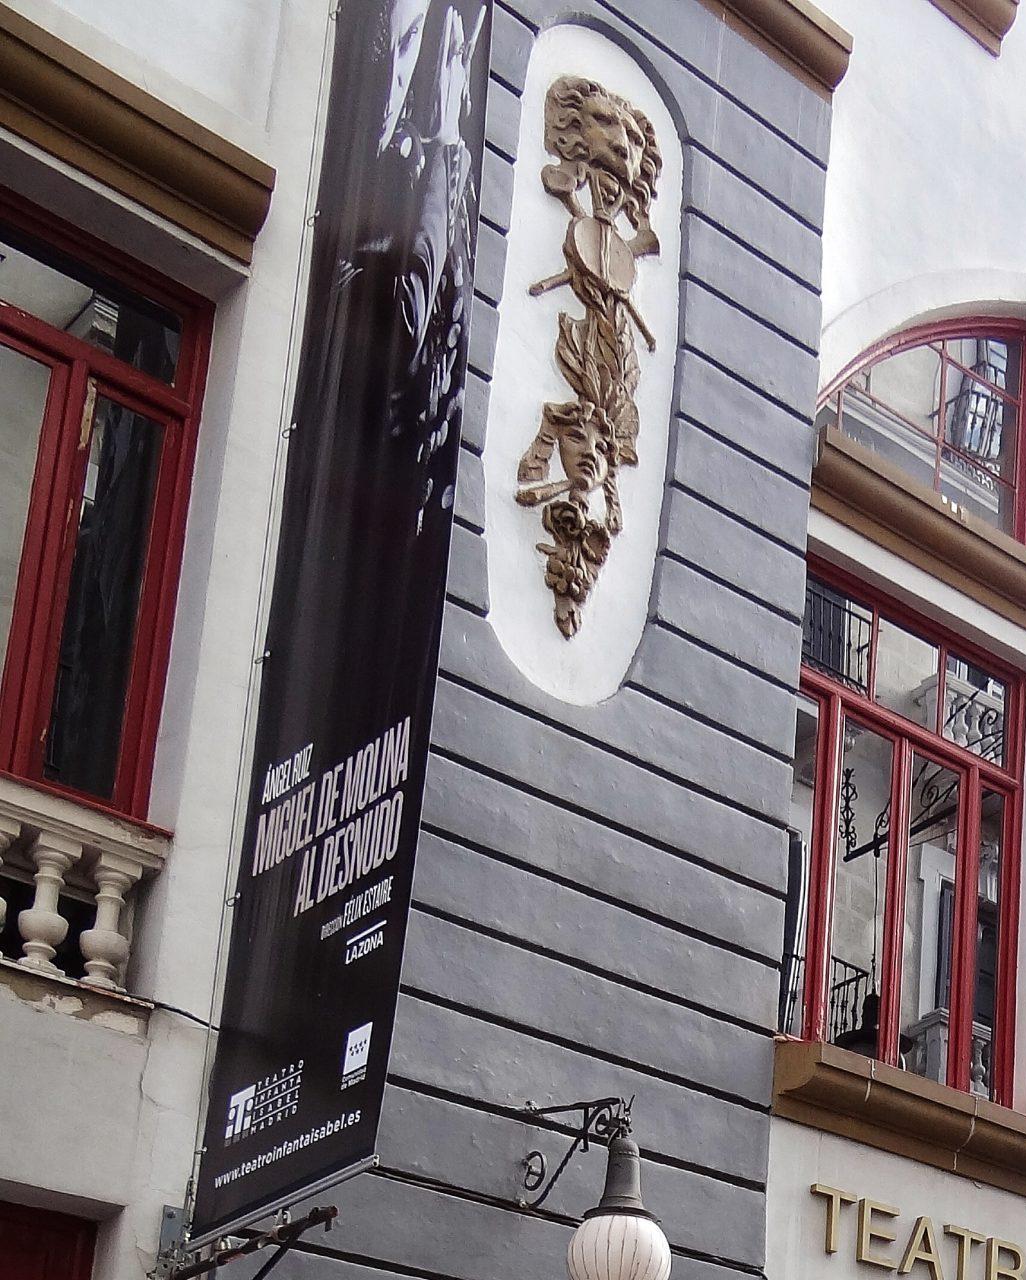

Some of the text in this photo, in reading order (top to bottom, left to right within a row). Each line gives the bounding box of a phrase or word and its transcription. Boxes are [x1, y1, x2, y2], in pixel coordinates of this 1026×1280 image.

[261, 743, 314, 805] ÁNGEL RUIZ
[252, 716, 411, 877] MIGUEL DE MOLINA
[293, 790, 404, 917] AL DESNUDO
[344, 930, 384, 965] LAZONA
[254, 1074, 302, 1105] INFANTA
[257, 1059, 304, 1090] TEATRO
[250, 1104, 298, 1136] MADRID
[252, 1089, 300, 1120] ISABEL
[213, 1108, 362, 1189] www.teatroinfantaisabel.es
